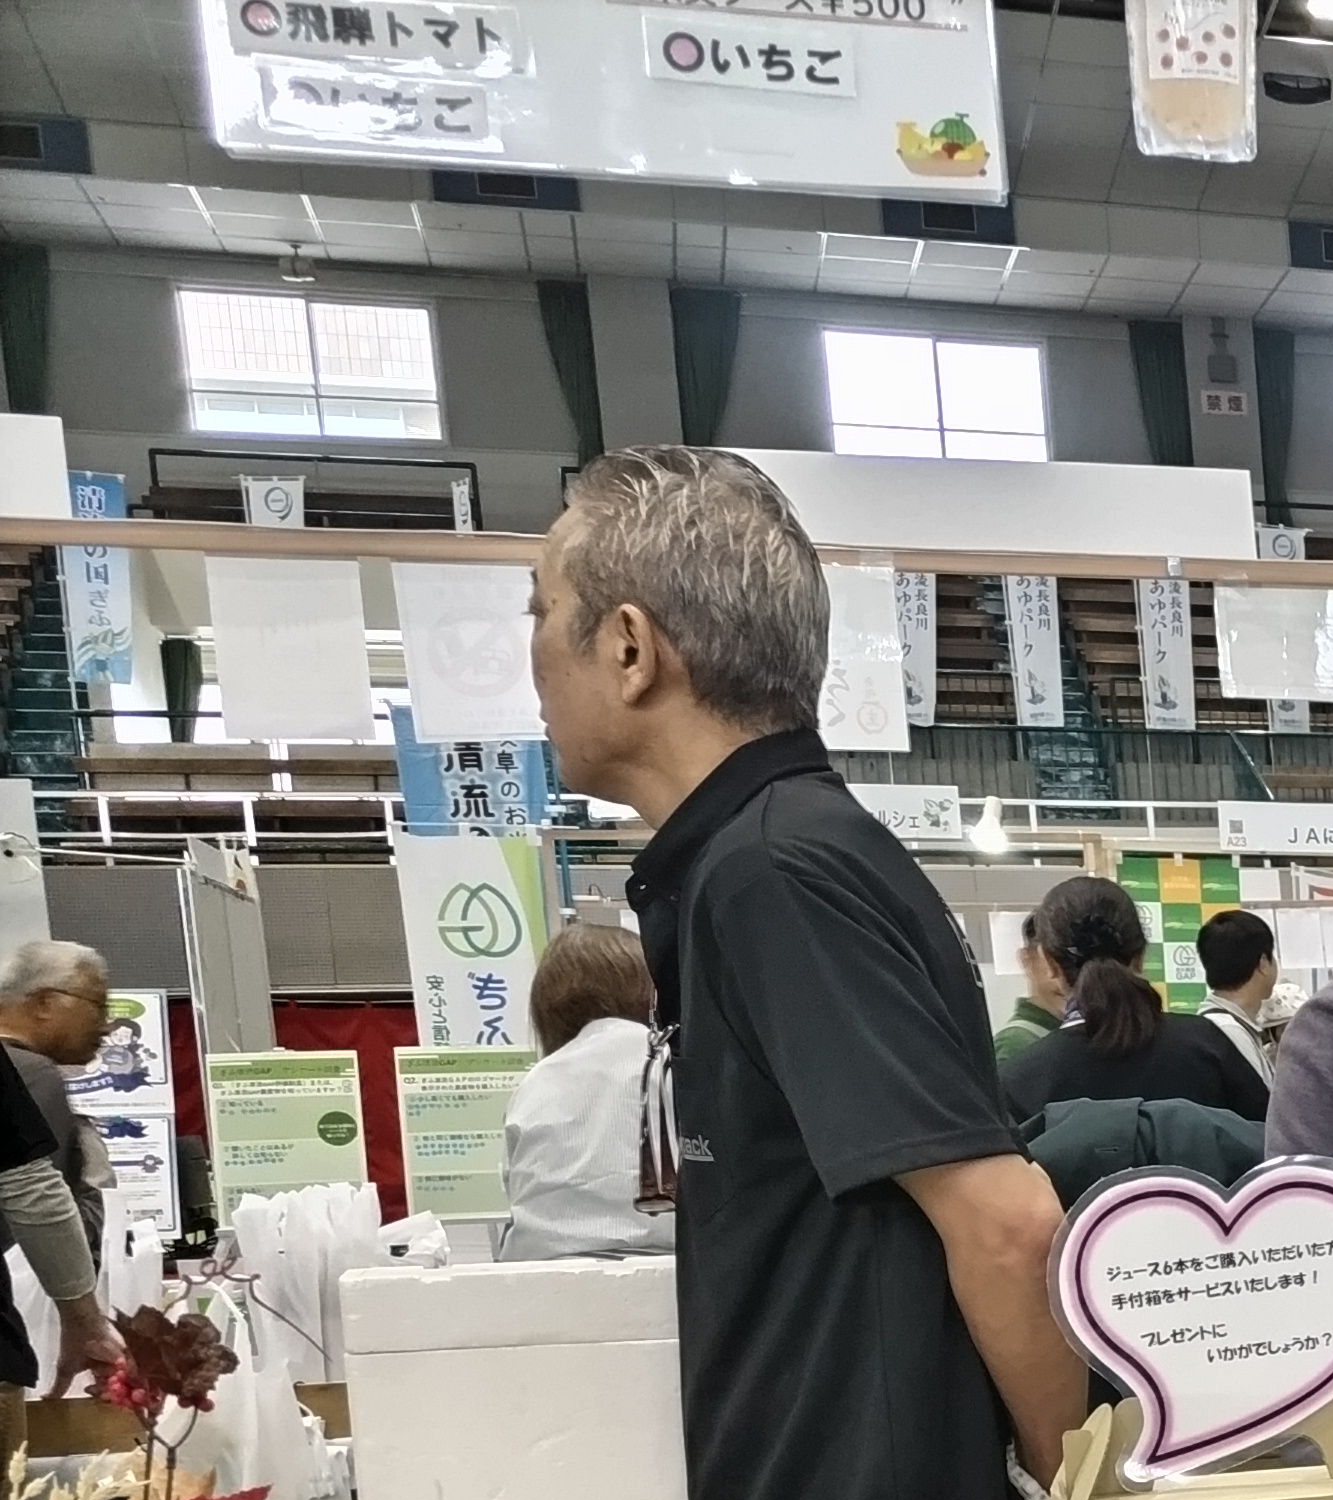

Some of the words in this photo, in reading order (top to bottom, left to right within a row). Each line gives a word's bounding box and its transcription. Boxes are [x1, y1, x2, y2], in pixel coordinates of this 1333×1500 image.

[1205, 394, 1245, 413] 禁煙
[1015, 576, 1035, 659] あゆパーク
[1148, 580, 1169, 665] あゆパーク
[869, 809, 921, 830] ルシェ
[1226, 836, 1247, 847] A23
[1175, 972, 1197, 981] GAP
[1110, 1270, 1319, 1312] 手付箱をサービスいたします！
[1139, 1323, 1229, 1348] プレゼントに
[1206, 1332, 1333, 1364] いかがでしょうか？
